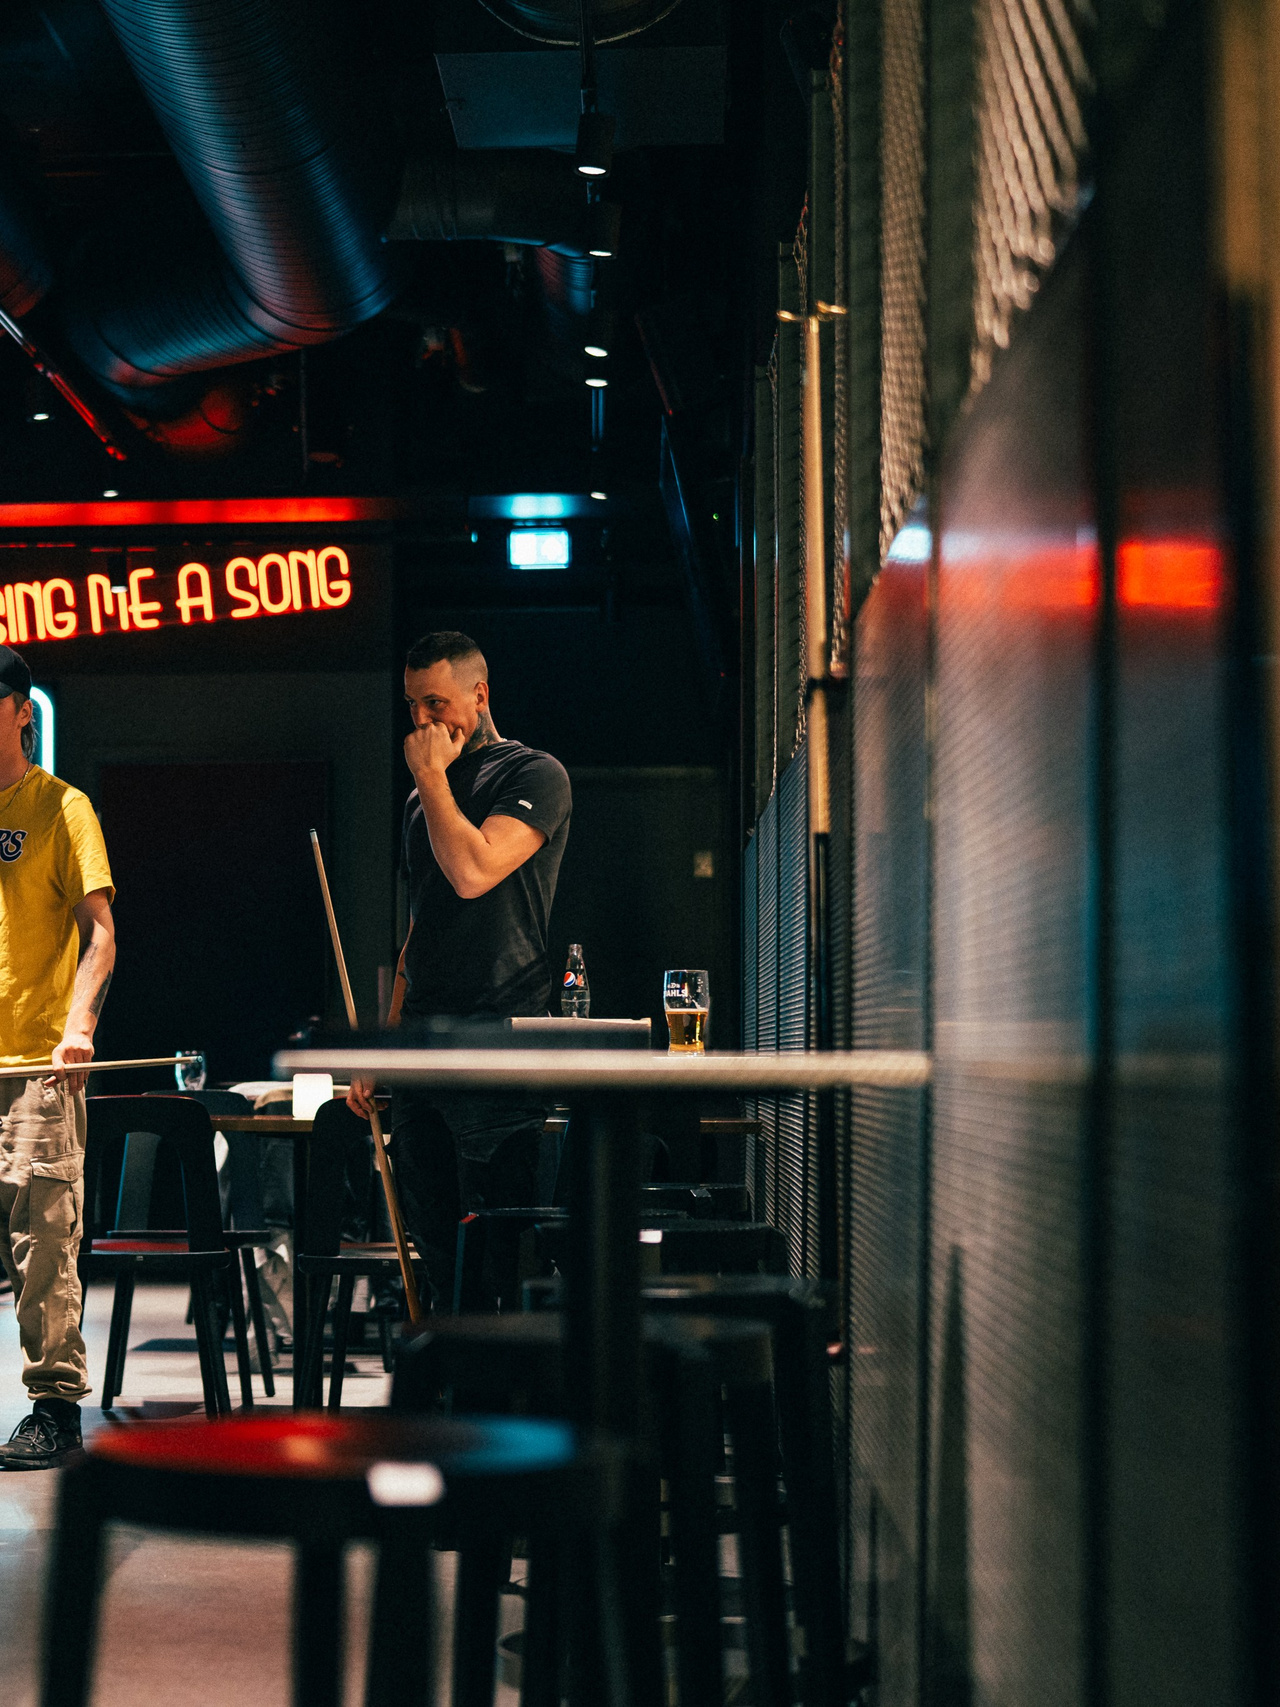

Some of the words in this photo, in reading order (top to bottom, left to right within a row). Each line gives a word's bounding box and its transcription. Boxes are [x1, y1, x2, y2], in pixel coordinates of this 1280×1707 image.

[87, 567, 161, 633] ME
[176, 562, 213, 623] A
[225, 546, 351, 618] SONG
